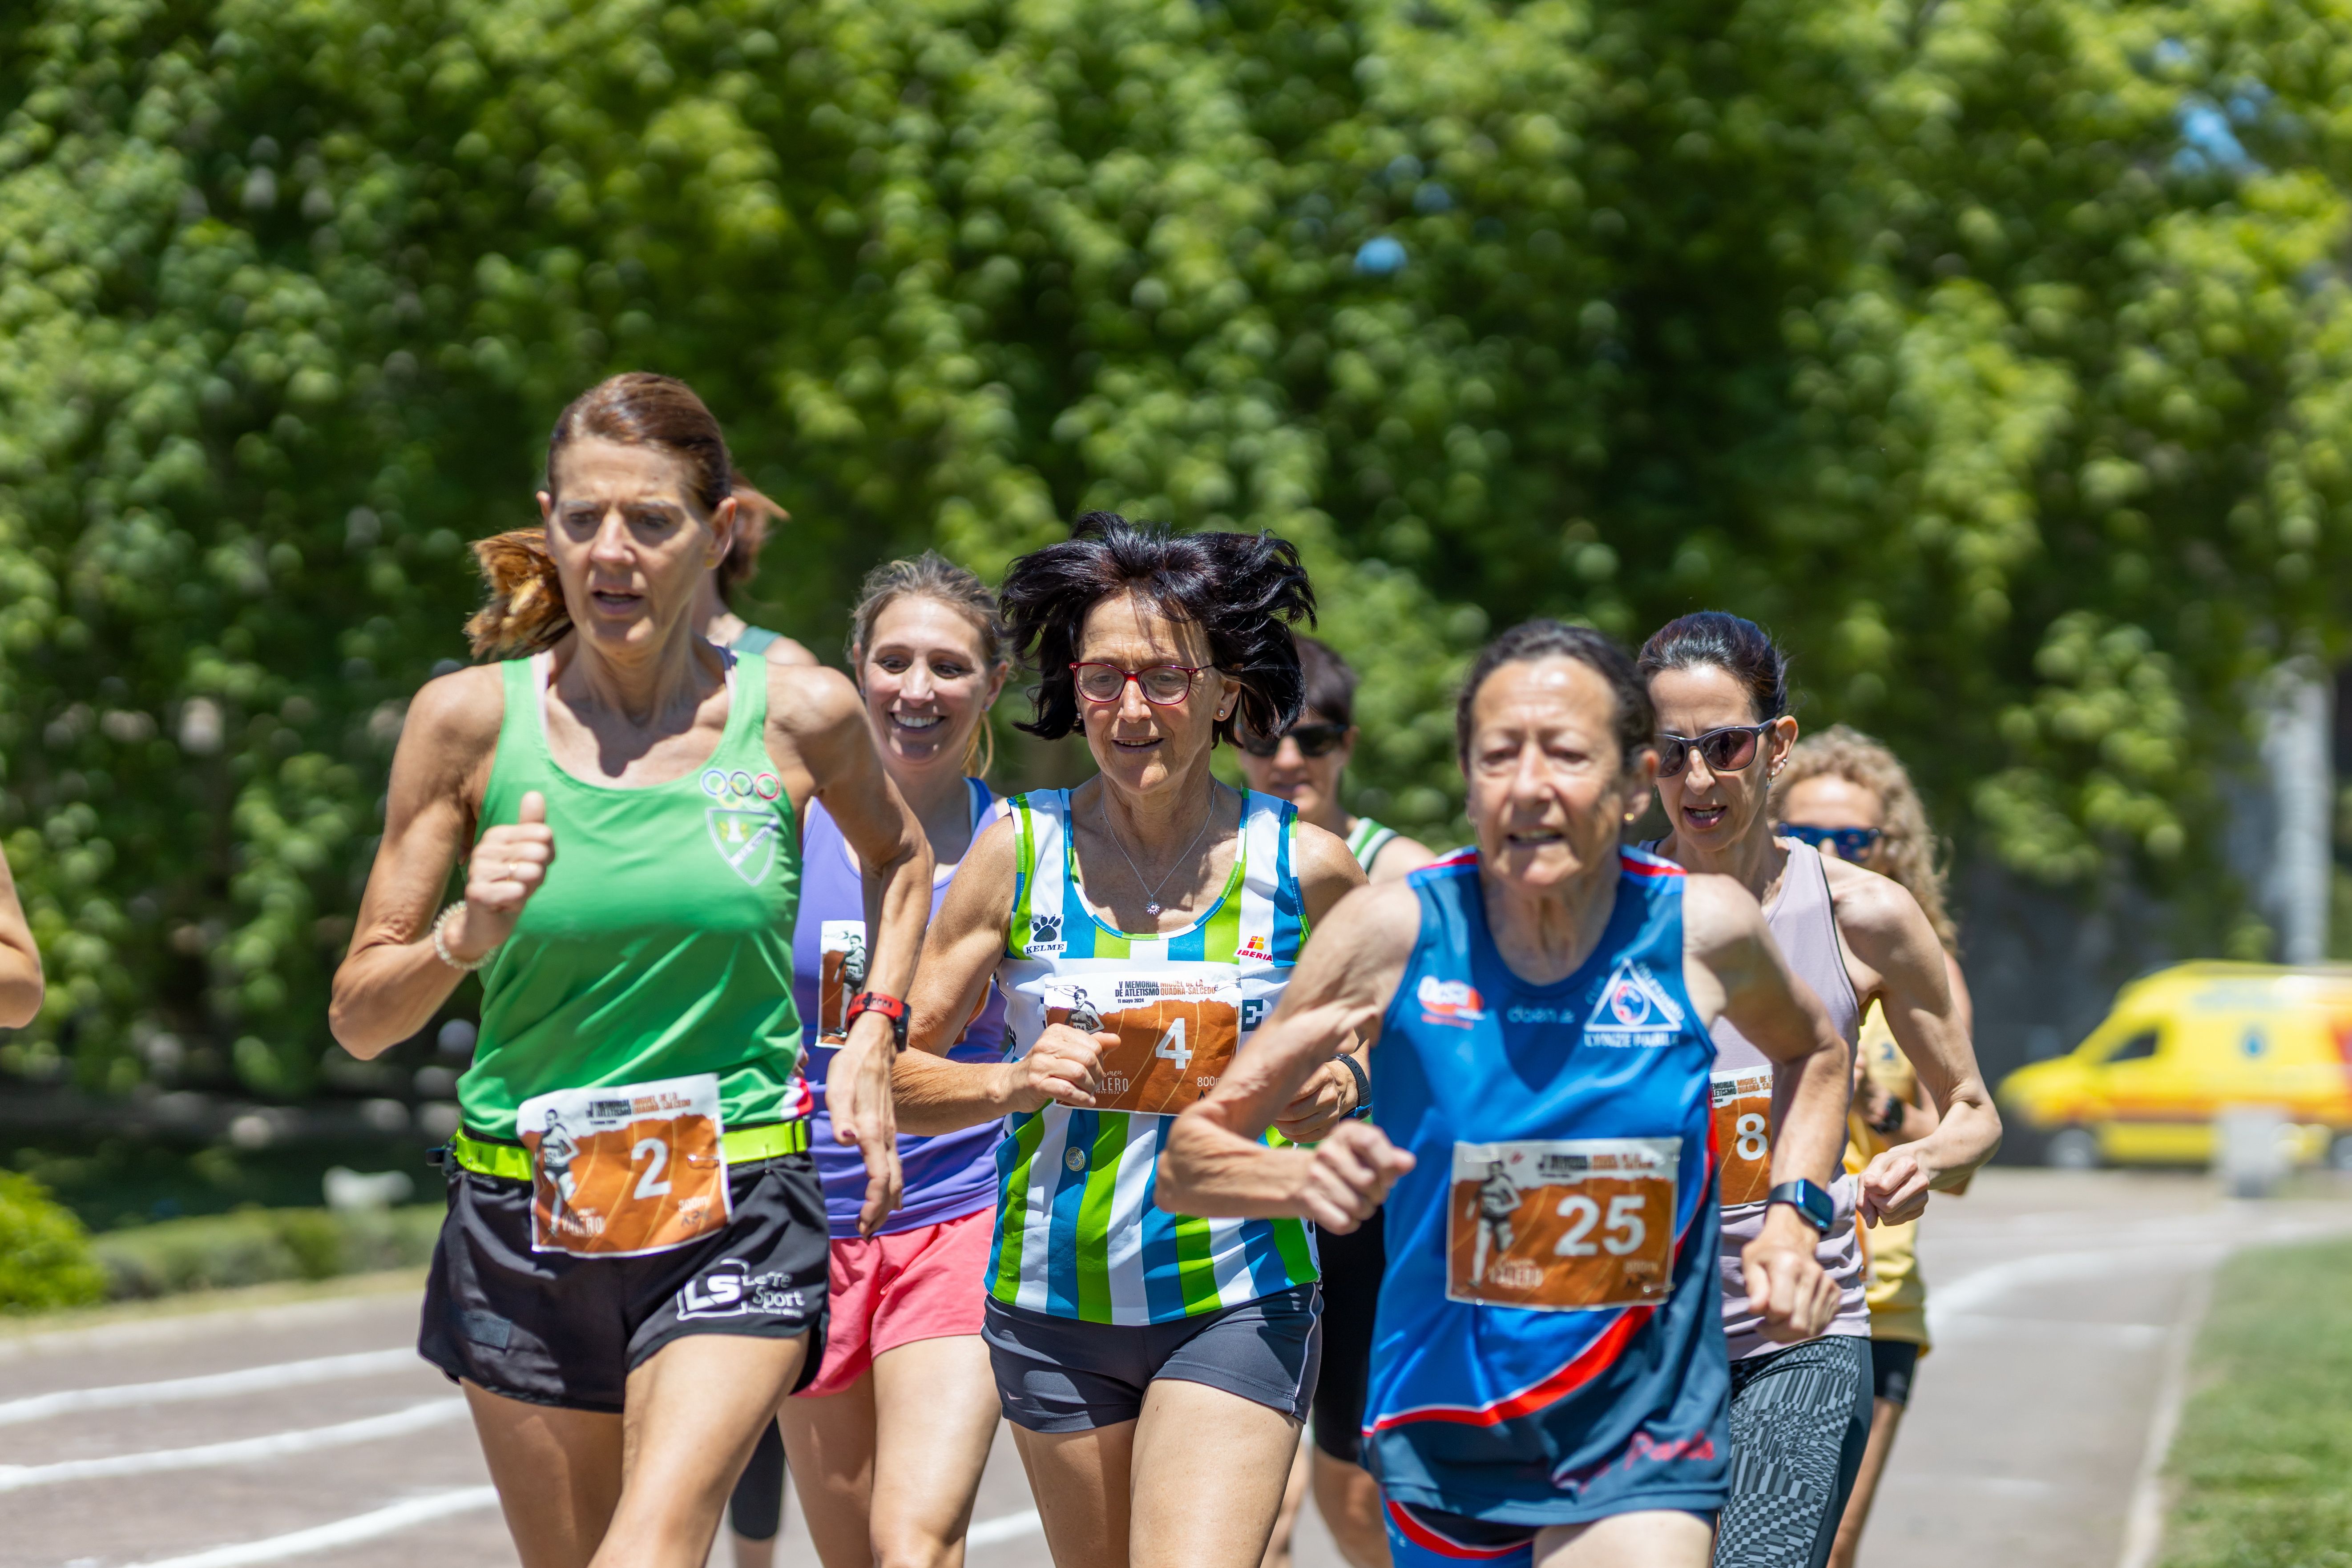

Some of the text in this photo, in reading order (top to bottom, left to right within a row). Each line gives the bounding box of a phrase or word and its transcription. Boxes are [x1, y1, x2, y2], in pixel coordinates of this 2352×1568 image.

[1026, 944, 1064, 954] KELME
[1237, 950, 1272, 962] IBERIA
[1125, 980, 1159, 988] MEMORIAL
[1196, 979, 1203, 987] LA
[1125, 988, 1159, 996] ATLETISMO
[1160, 987, 1215, 996] QUADRA-SALCEDO
[1155, 1017, 1192, 1069] 4
[1101, 1078, 1129, 1092] LERO
[1711, 1080, 1734, 1089] EMORIAL
[1737, 1077, 1757, 1086] MIGUEL
[1712, 1082, 1772, 1097] LETISMO QUADRA-SAL
[1736, 1113, 1768, 1161] 8
[631, 1137, 671, 1199] 2
[1553, 1194, 1646, 1256] 25
[752, 1286, 806, 1309] Sport
